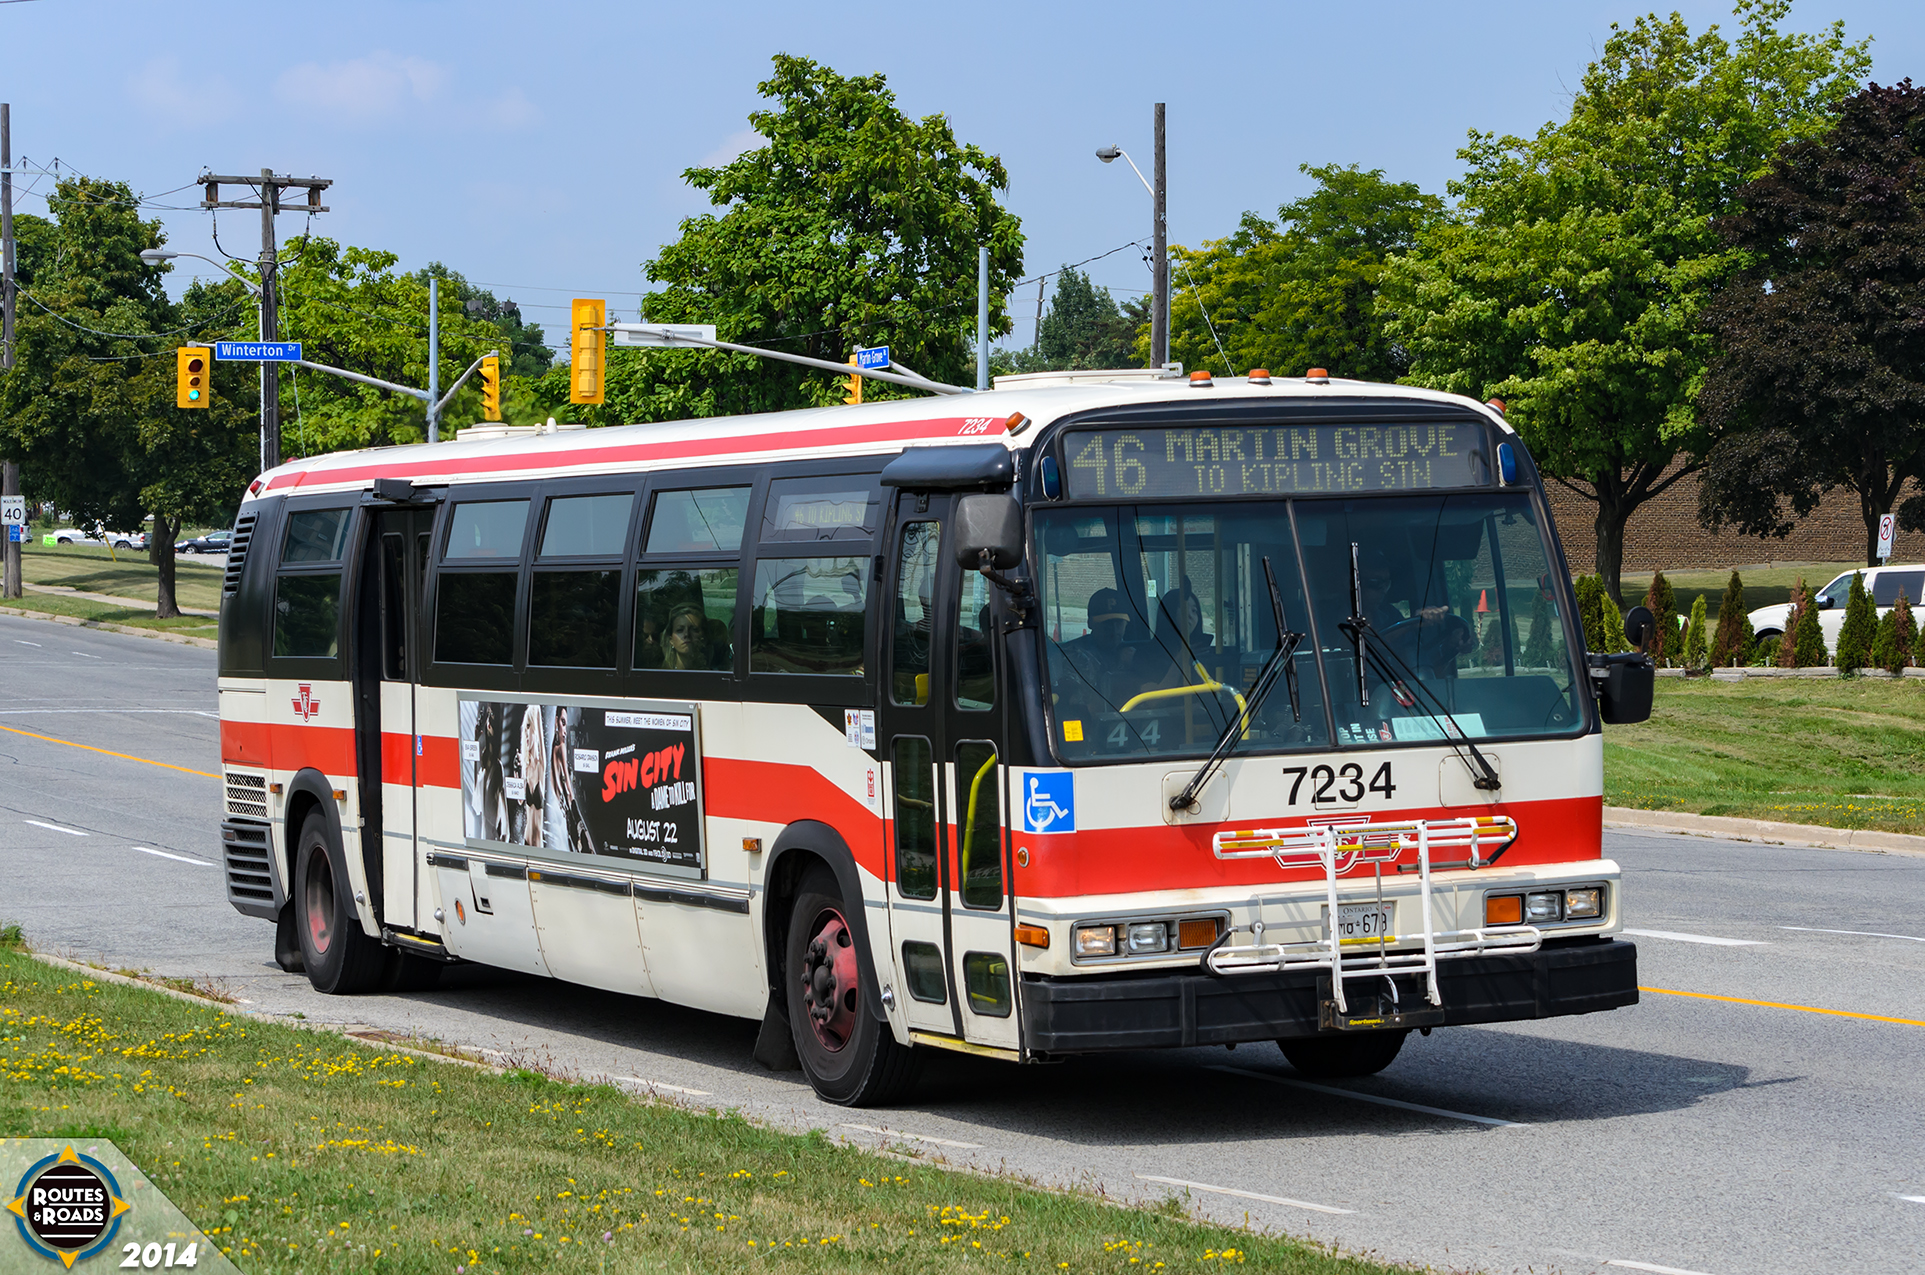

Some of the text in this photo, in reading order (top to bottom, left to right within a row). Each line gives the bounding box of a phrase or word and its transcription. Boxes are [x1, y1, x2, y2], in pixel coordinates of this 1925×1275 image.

[221, 343, 296, 356] Winterton Dr
[872, 350, 883, 364] Grove
[957, 417, 993, 435] 7234
[1165, 425, 1458, 462] MARTIN GROVE
[1073, 434, 1146, 495] 46
[1194, 460, 1431, 493] TO KIPLING STN
[4, 508, 22, 520] 40
[808, 506, 817, 523] TO
[819, 505, 853, 523] KIPLING
[602, 741, 686, 803] SIN CITY
[1282, 761, 1397, 806] 7234
[674, 781, 687, 806] KILL
[685, 781, 696, 801] FOR
[626, 817, 678, 843] AUGUST 22
